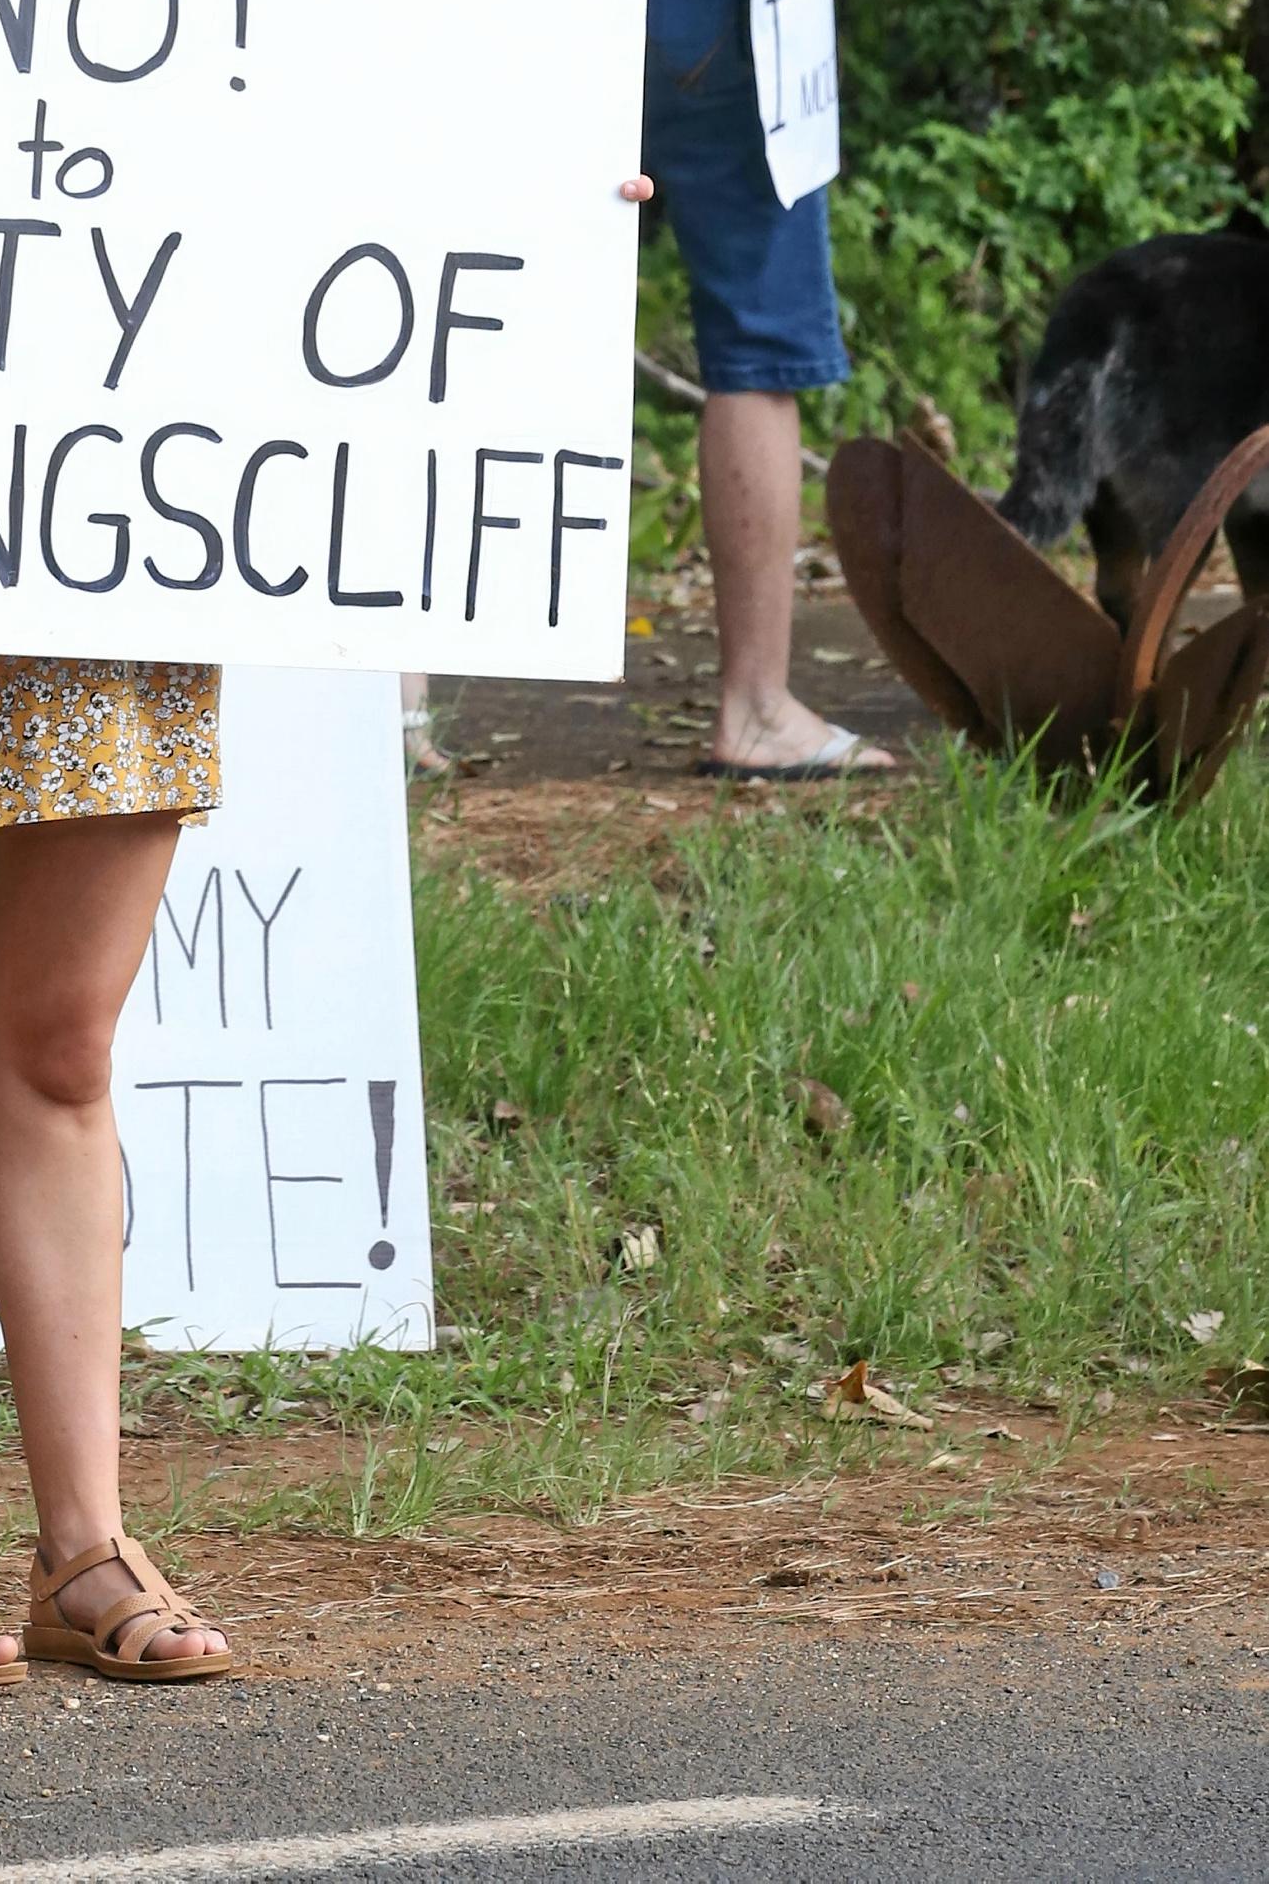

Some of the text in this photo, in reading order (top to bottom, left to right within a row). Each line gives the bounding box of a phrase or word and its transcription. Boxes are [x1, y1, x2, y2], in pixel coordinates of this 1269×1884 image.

[17, 98, 114, 200] to
[302, 242, 526, 404] OF
[152, 866, 302, 1031] MY
